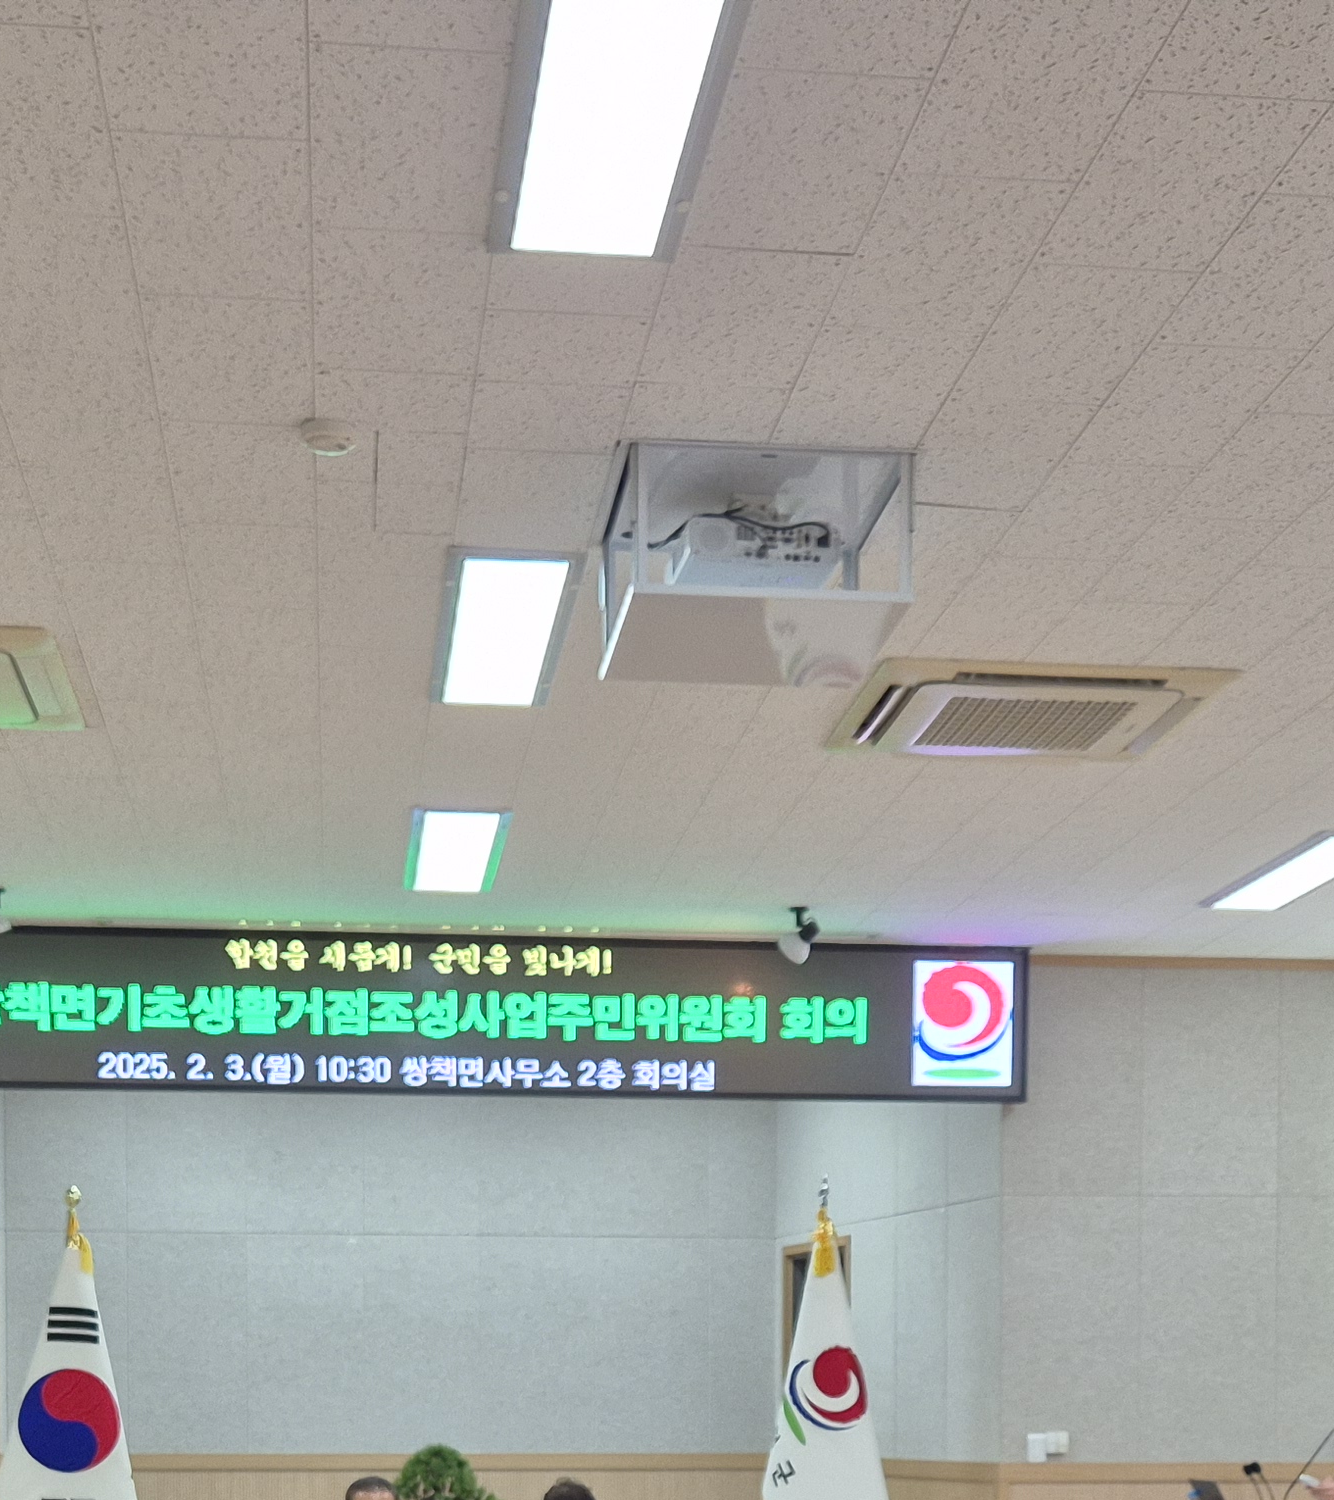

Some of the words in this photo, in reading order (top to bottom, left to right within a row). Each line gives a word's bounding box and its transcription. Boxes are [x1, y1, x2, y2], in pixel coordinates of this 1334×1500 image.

[428, 943, 512, 976] 군민을
[522, 944, 613, 977] 빛나게!
[778, 995, 868, 1045] 회의
[97, 1051, 175, 1081] 2025.
[186, 1052, 215, 1081] 2.
[225, 1052, 305, 1085] 3.(월)
[316, 1055, 391, 1084] 10:30
[399, 1056, 569, 1090] 쌍책면사무소
[578, 1060, 625, 1090] 2층
[632, 1060, 716, 1091] 회의실
